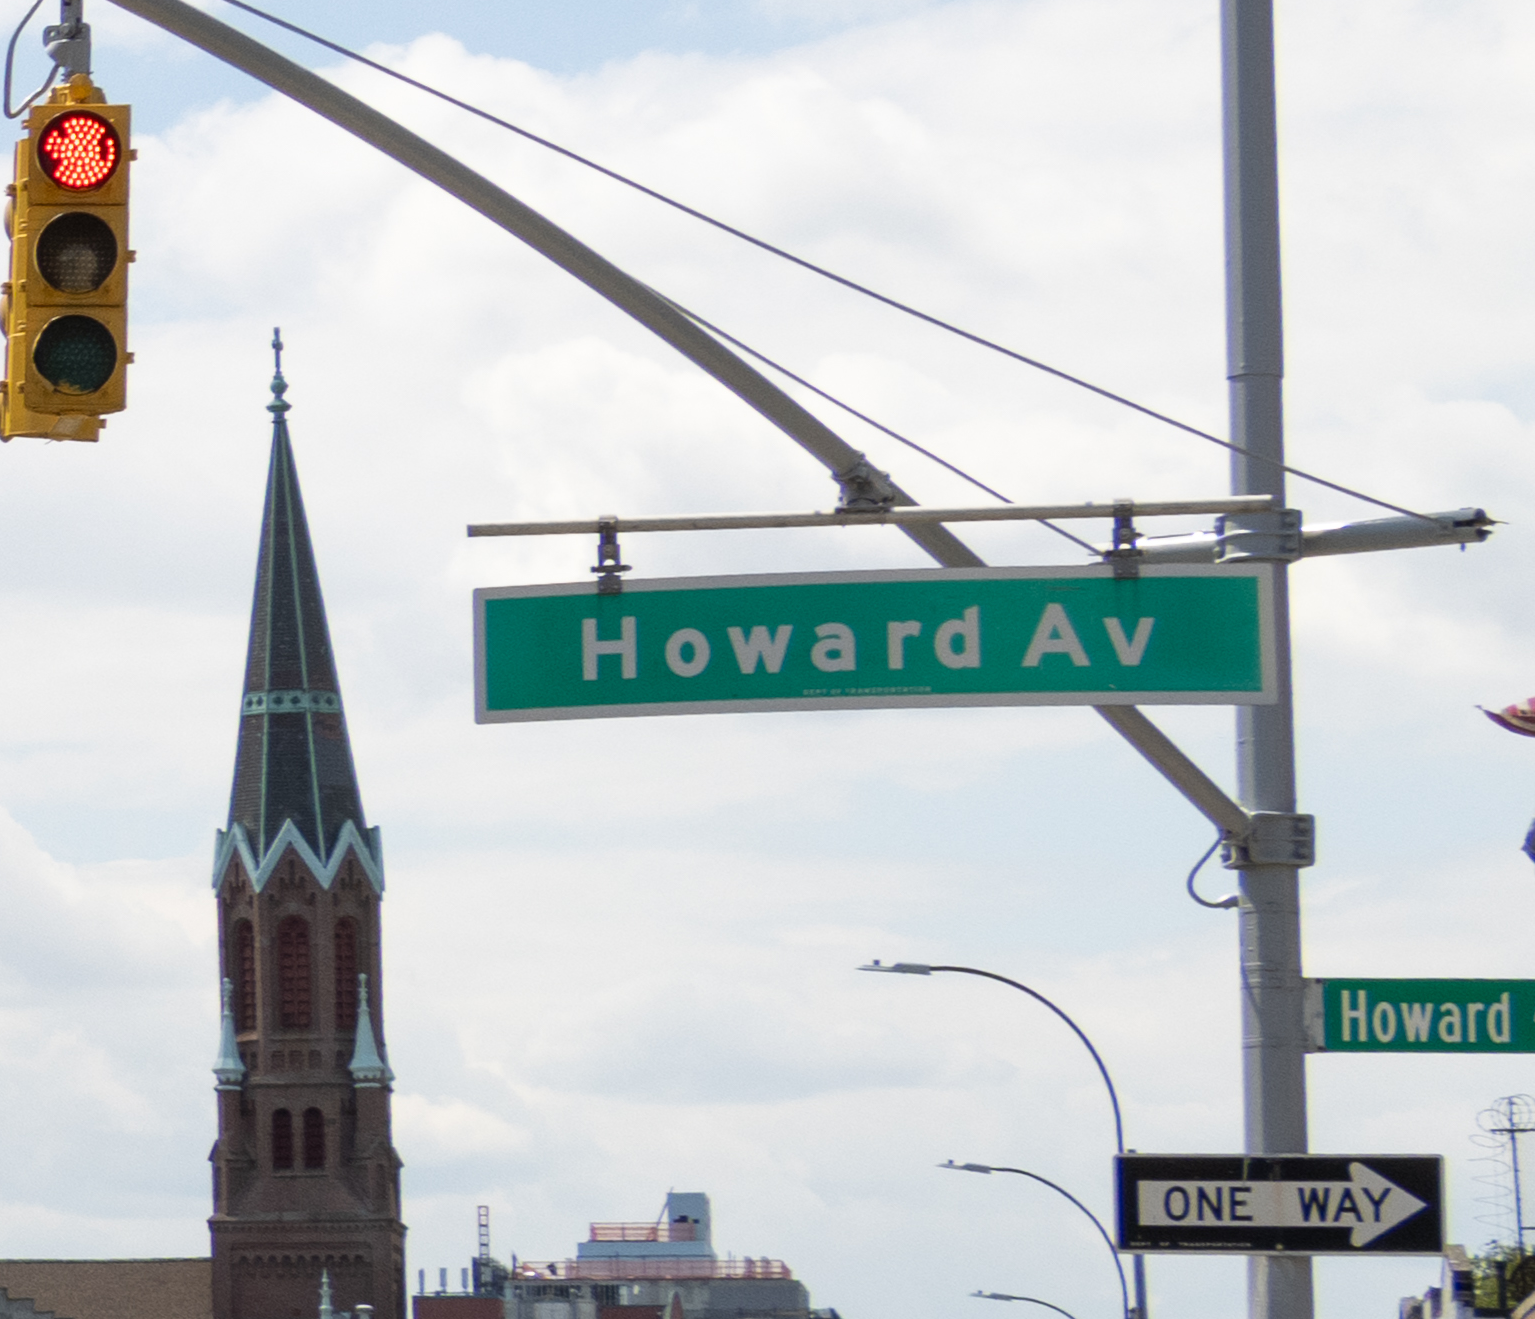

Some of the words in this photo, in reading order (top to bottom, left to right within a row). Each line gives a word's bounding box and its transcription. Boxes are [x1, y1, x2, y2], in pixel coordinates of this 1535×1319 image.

[581, 604, 982, 681] Howard
[1021, 602, 1156, 668] Av
[1341, 989, 1511, 1043] Howard
[1163, 1185, 1254, 1222] ONE
[1297, 1187, 1393, 1223] WAY
